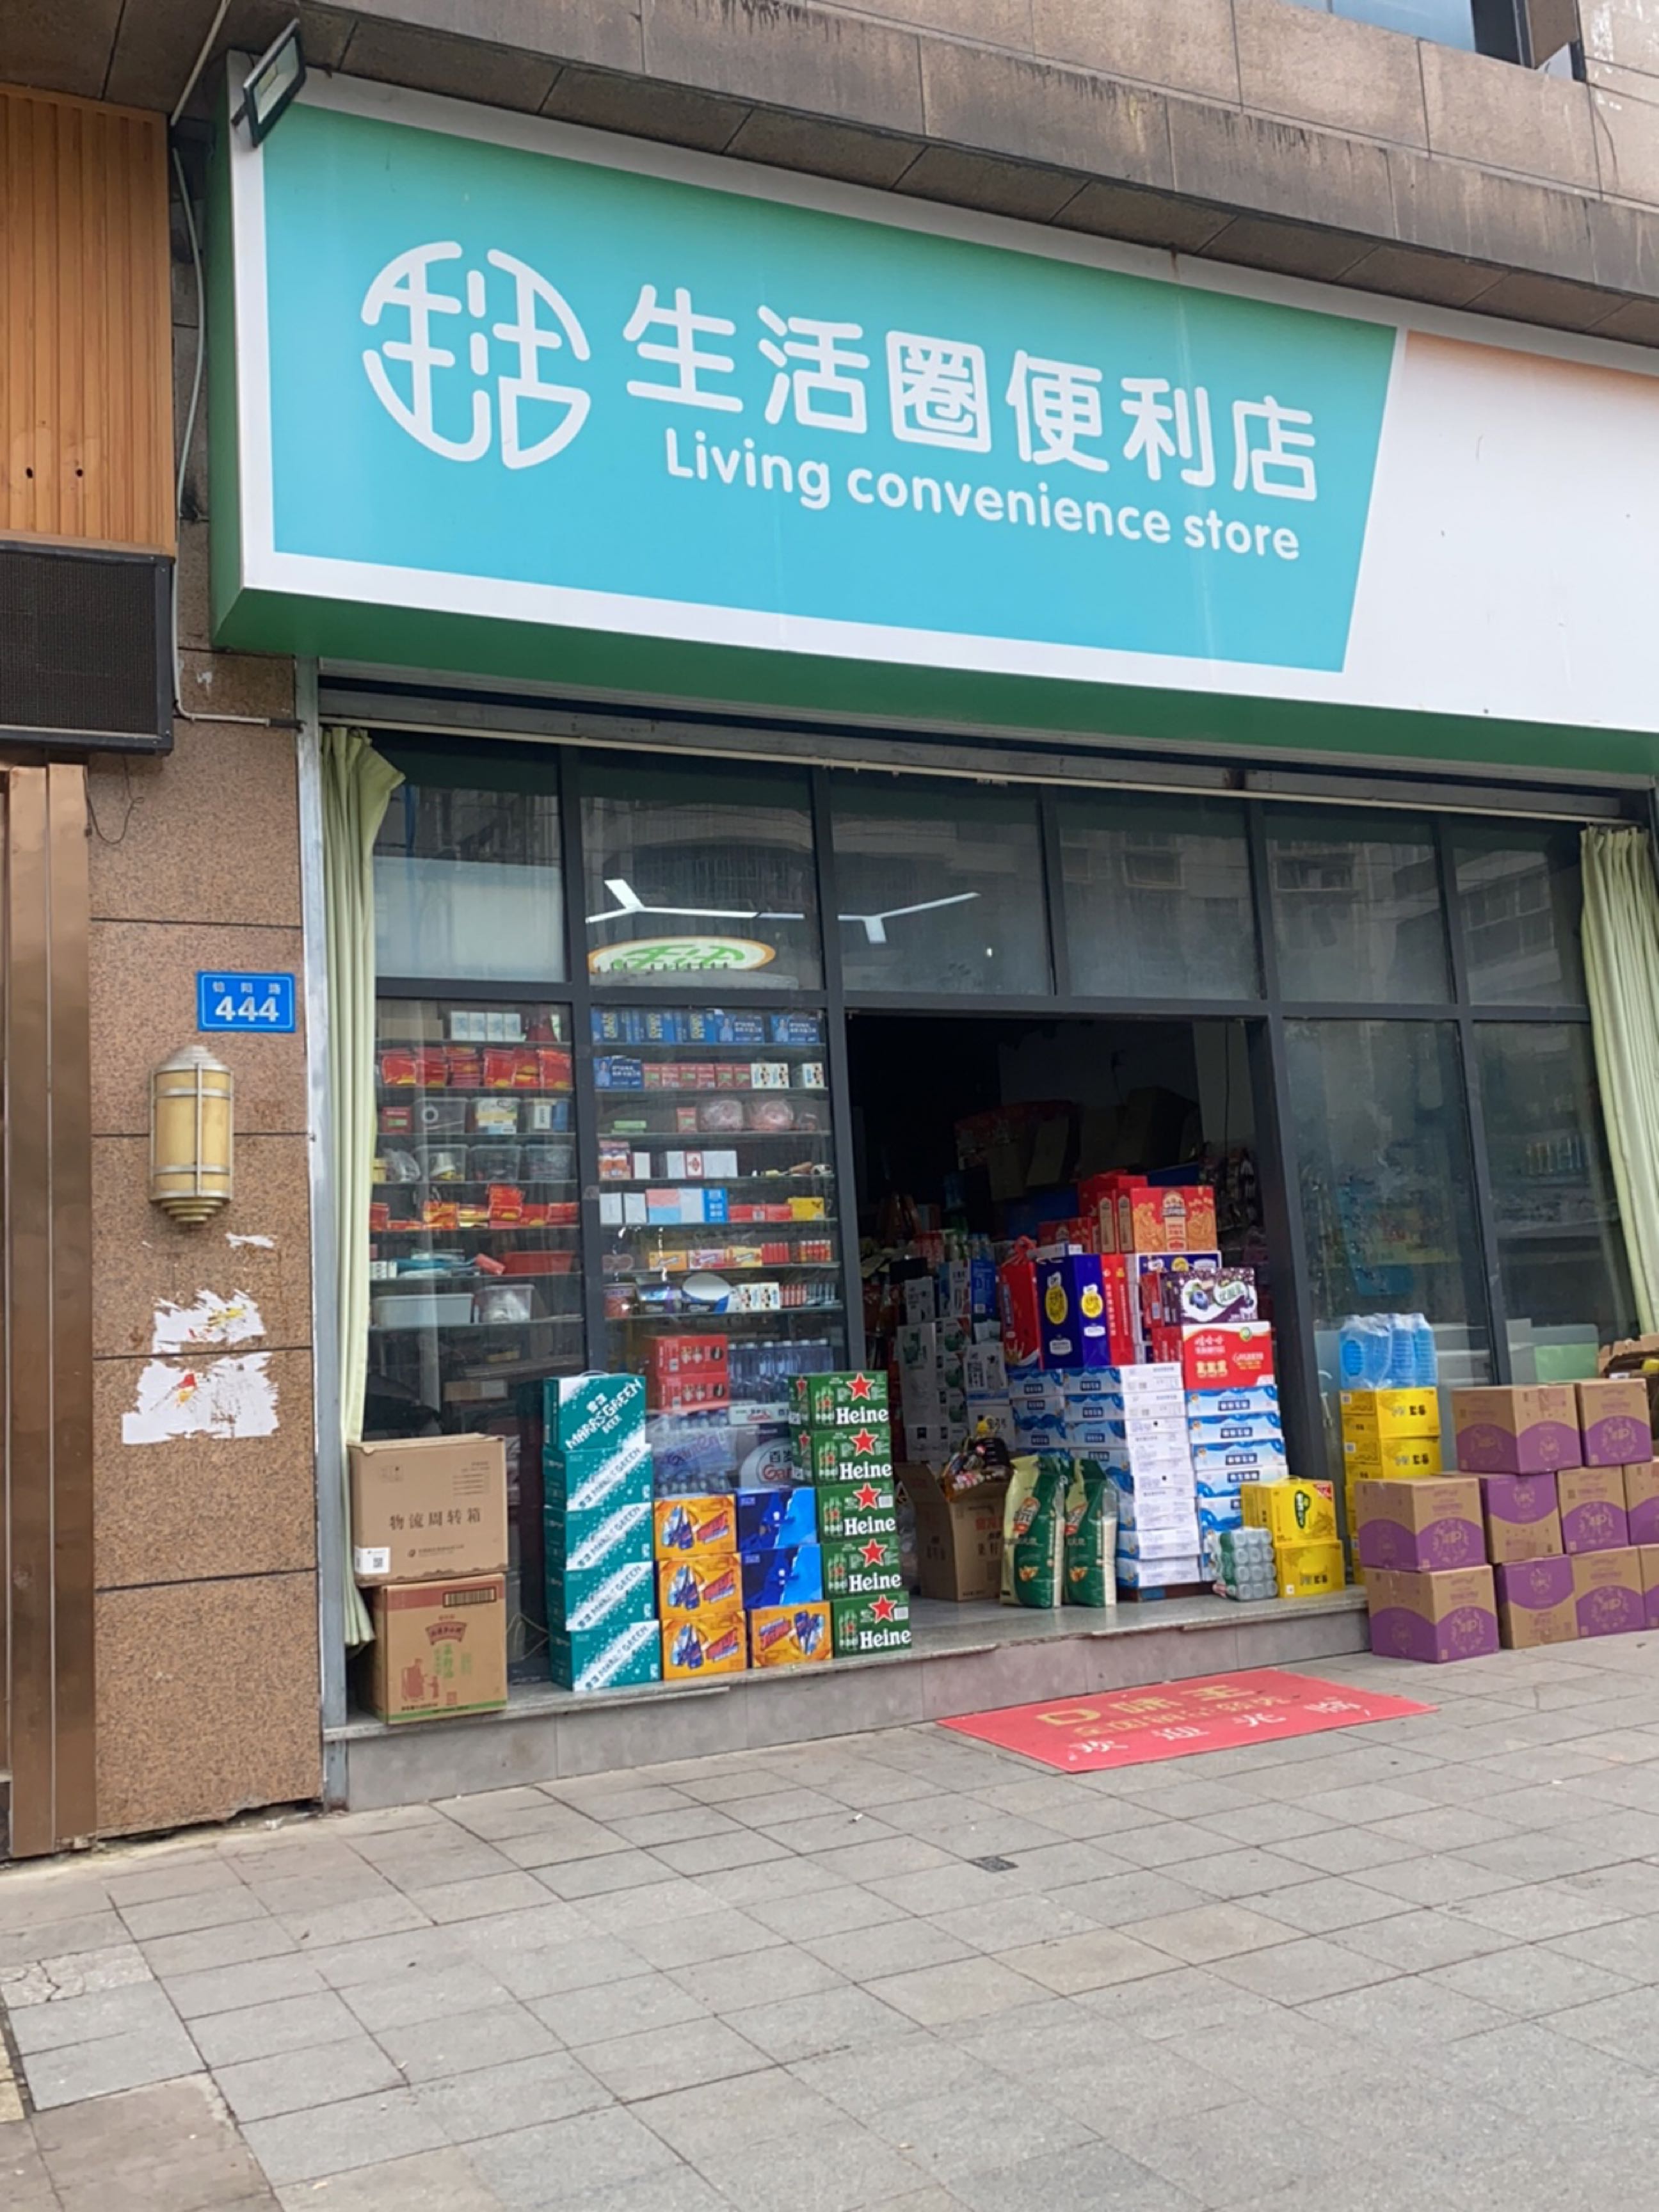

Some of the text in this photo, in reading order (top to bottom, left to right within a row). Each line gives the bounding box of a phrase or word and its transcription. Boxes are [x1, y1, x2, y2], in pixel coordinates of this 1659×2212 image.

[623, 285, 1317, 501] 生活圈便利店
[666, 428, 1300, 560] Living convenience store
[214, 996, 280, 1022] 444
[835, 1406, 889, 1425] Heine
[839, 1461, 892, 1480] Heine
[390, 1507, 481, 1530] 物流周转箱
[844, 1516, 896, 1535] Heine
[849, 1572, 902, 1592] Heine
[860, 1628, 911, 1650] Heine
